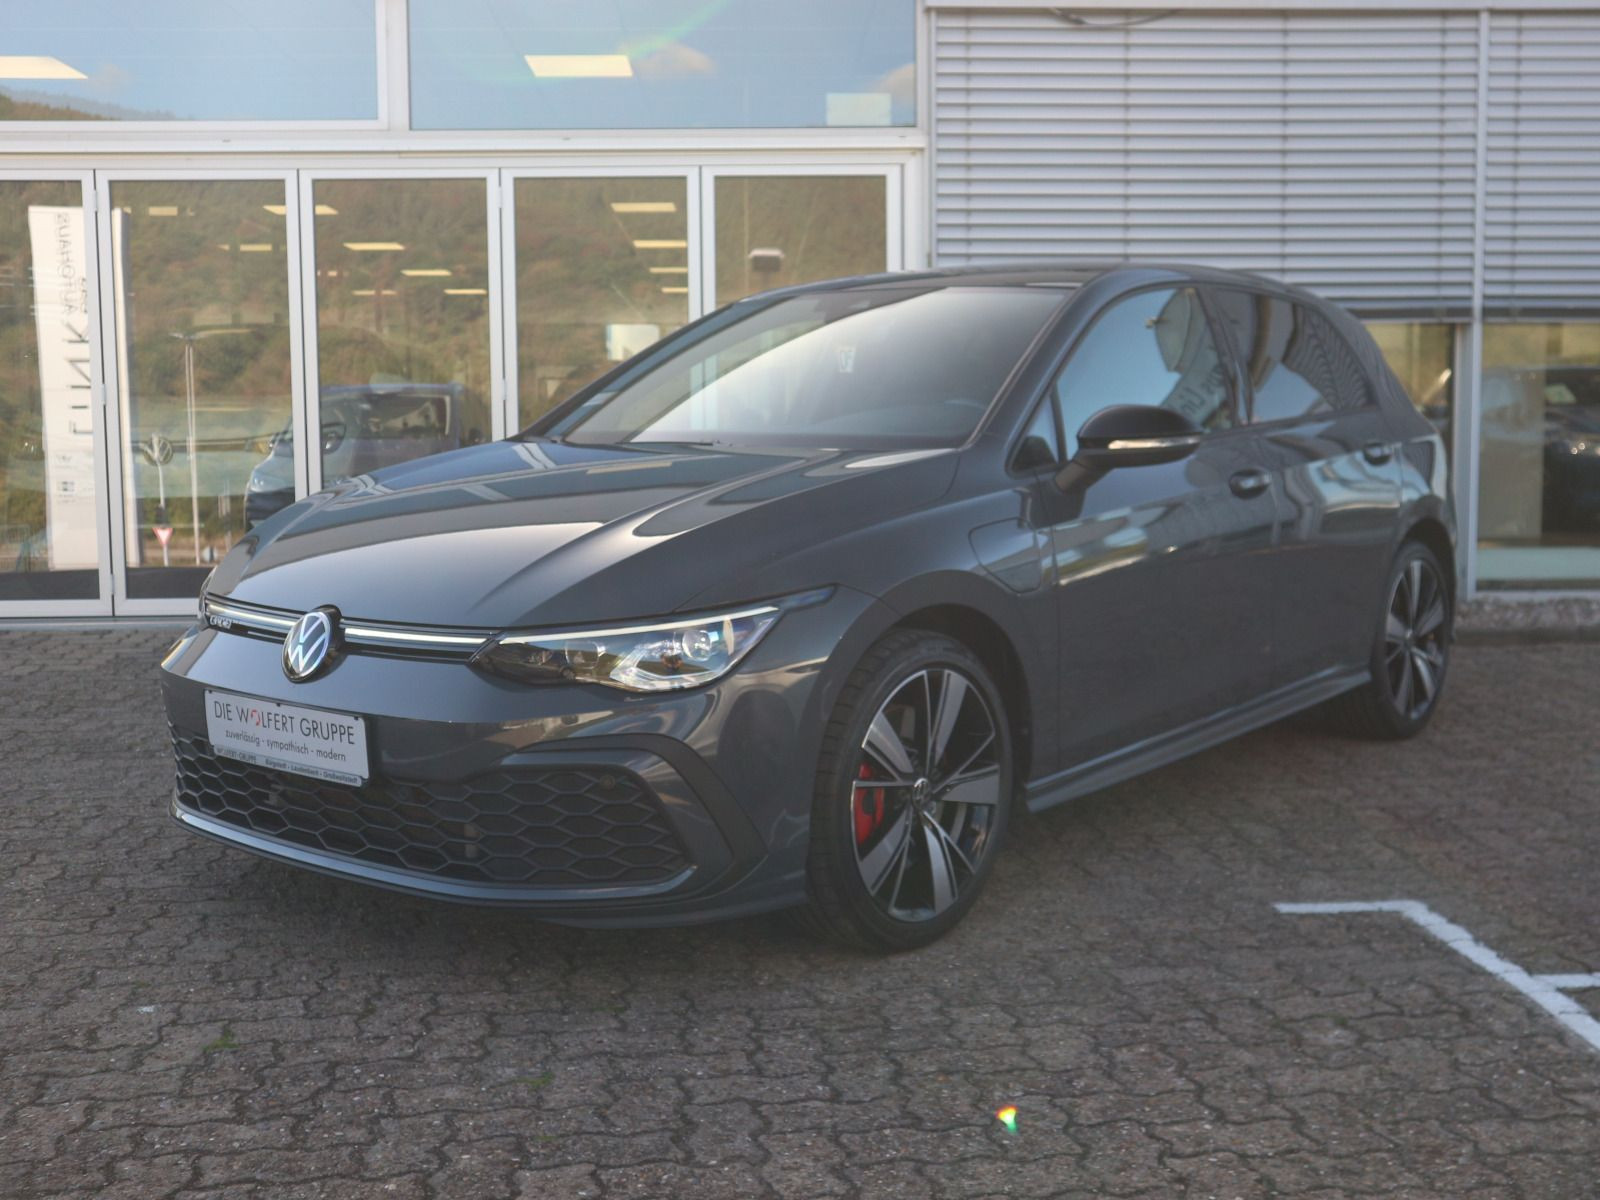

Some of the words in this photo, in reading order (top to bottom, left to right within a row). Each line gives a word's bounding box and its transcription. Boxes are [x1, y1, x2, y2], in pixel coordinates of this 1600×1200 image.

[214, 700, 233, 722] DIE
[236, 705, 295, 734] WOLFERT
[299, 717, 356, 745] GRUPPE
[225, 729, 261, 747] zuverlässig
[266, 738, 309, 755] sympathisch
[316, 748, 347, 762] modern
